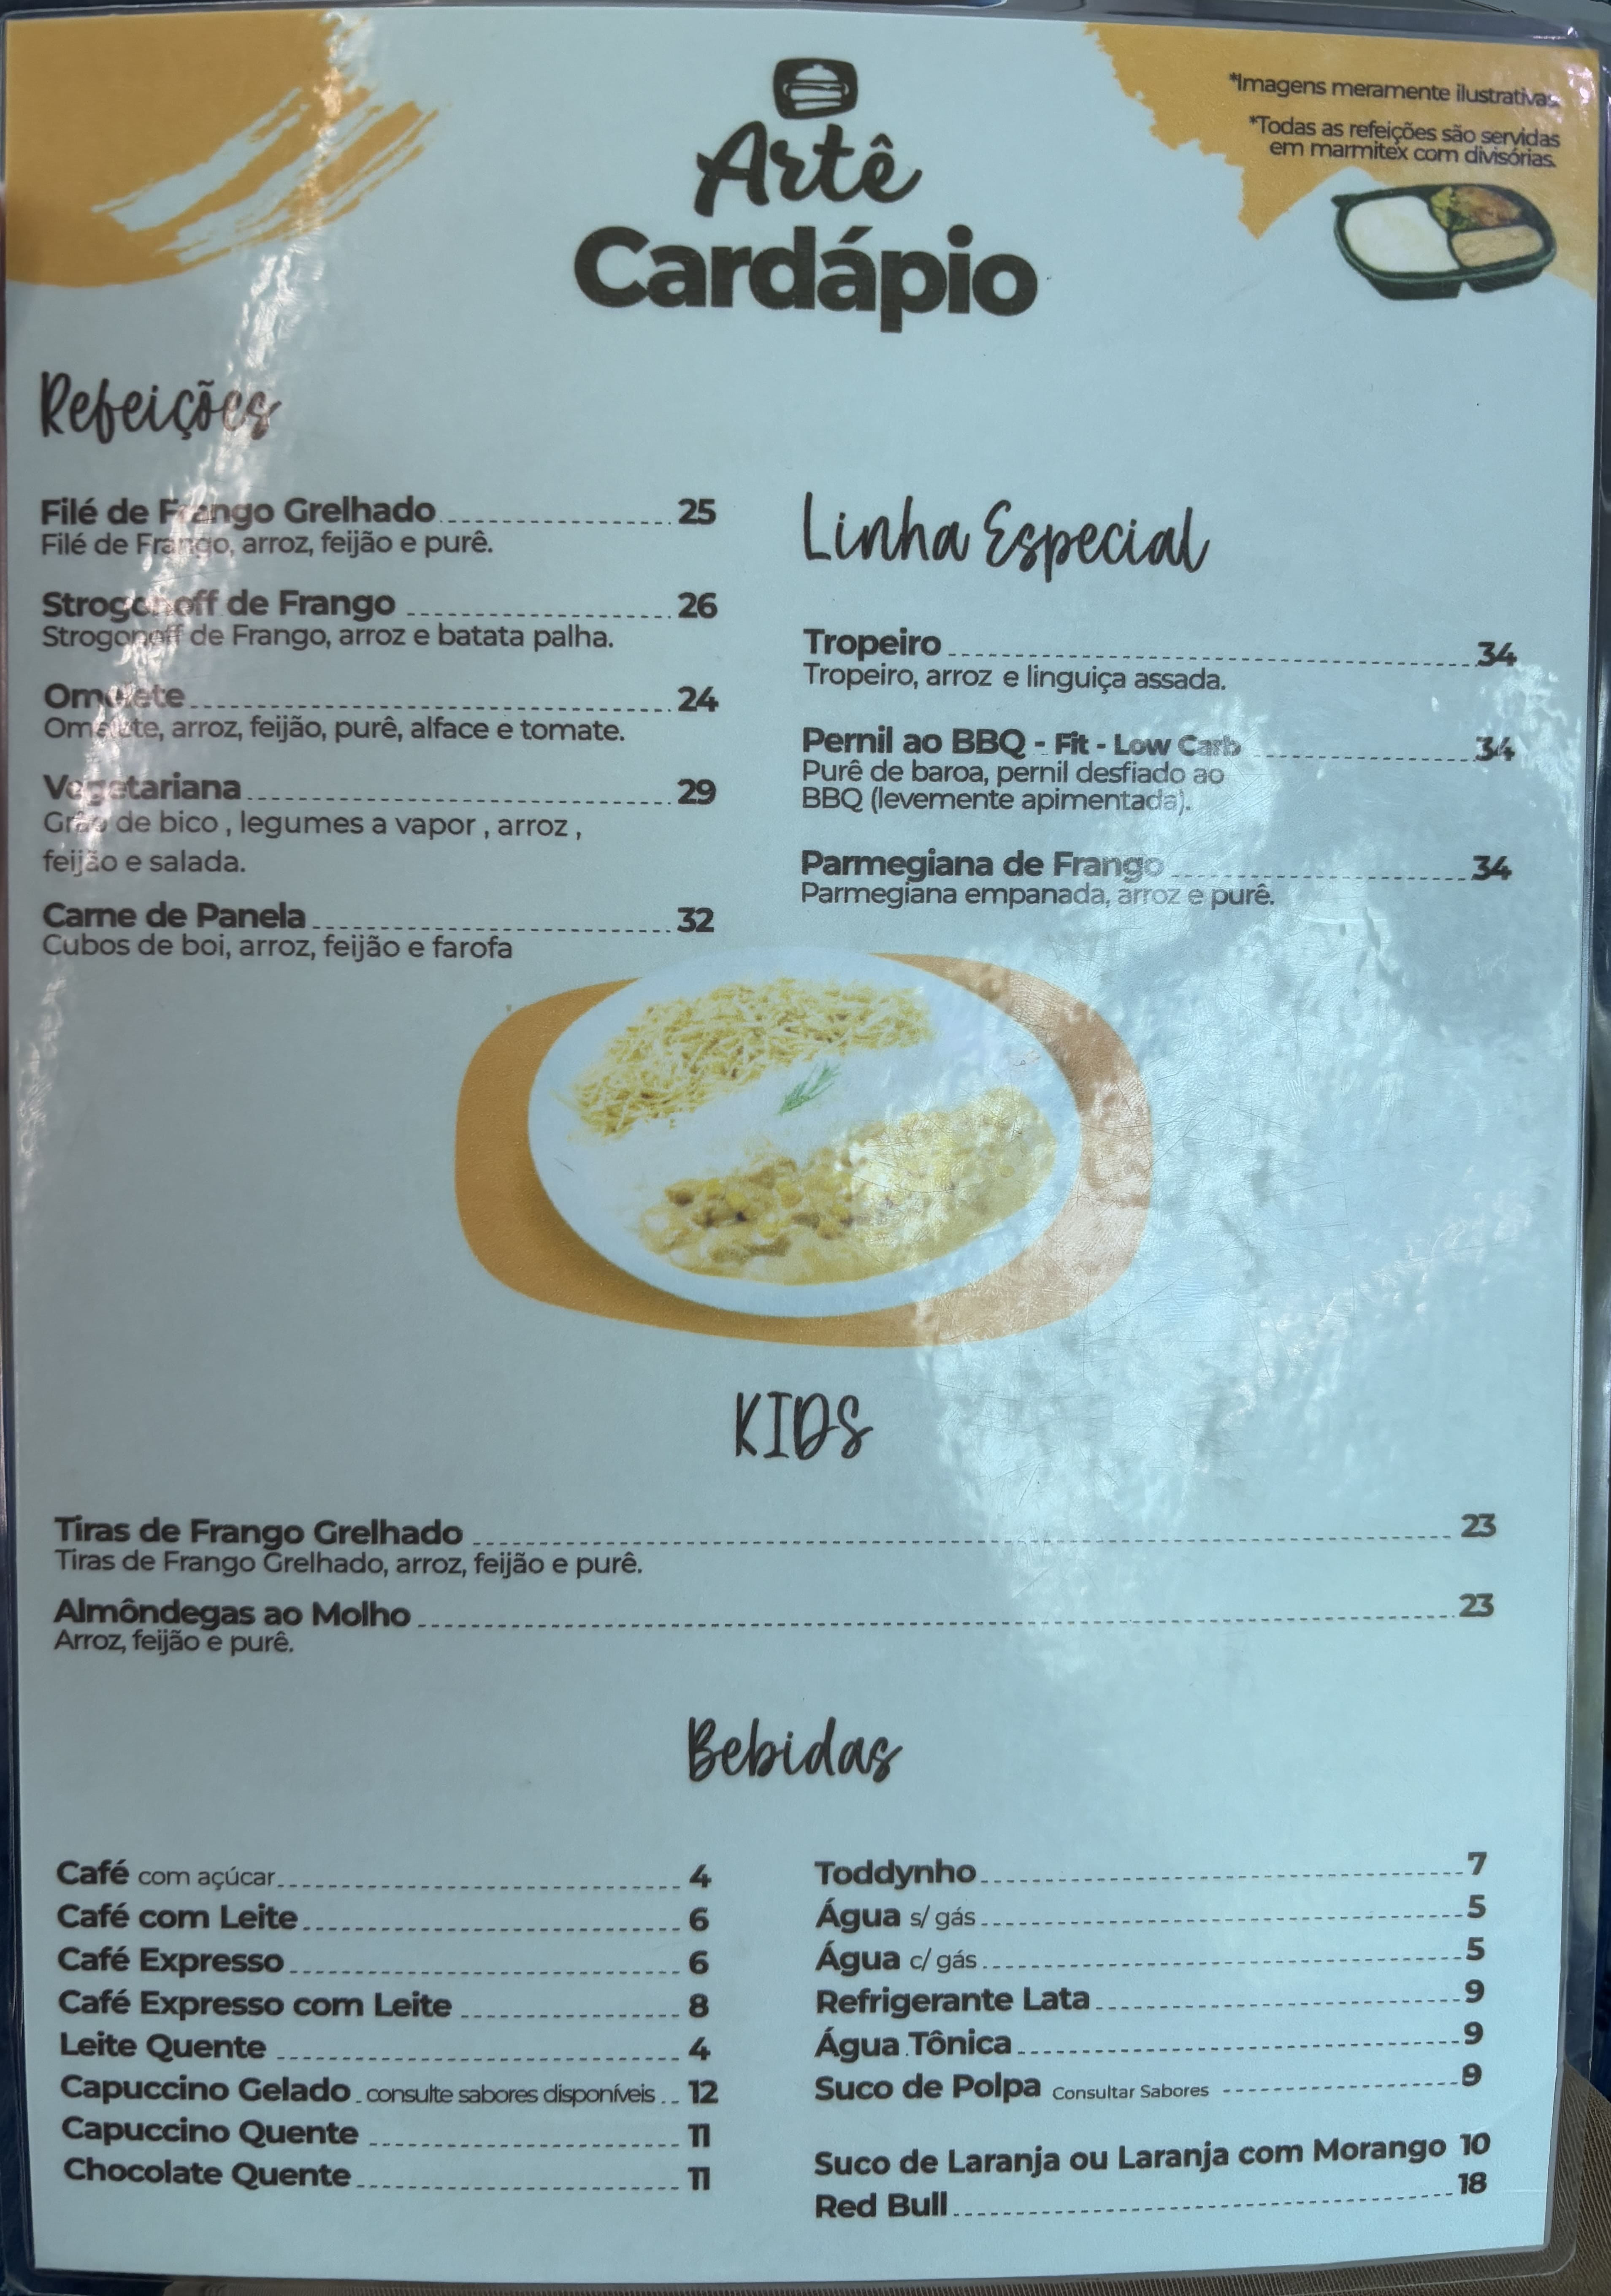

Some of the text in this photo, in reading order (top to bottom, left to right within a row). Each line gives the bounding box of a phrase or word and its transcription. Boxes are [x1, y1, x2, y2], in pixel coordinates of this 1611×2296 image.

[1332, 81, 1451, 102] meramente
[1321, 122, 1344, 138] as
[1349, 119, 1438, 146] refeições
[1441, 124, 1476, 144] são
[1481, 127, 1561, 148] servidas
[693, 120, 923, 218] Artê
[1269, 141, 1557, 168] em marmitex com divisórias.
[573, 224, 1038, 333] Cardápio
[40, 371, 281, 445] Refeições
[41, 495, 717, 525] Filé de Grelhado 25
[41, 529, 493, 559] Filé de arroz, feijão e purê.
[803, 491, 1210, 583] Linha Especial
[227, 588, 718, 623] de Frango 26
[803, 627, 1518, 667] Tropeiro 34
[803, 662, 1226, 695] Tropeiro, arroz e linguiça assada.
[677, 685, 719, 712] 24
[802, 724, 1172, 760] Pernil ao BBQ Fit Low
[802, 758, 1225, 788] Purê de baroa, pernil desfiado ao
[677, 778, 717, 805] 29
[801, 847, 1513, 883] Parmegiana de 34
[42, 901, 715, 933] Carne de Panela 32
[42, 932, 512, 963] Cubos de boi, arroz, feijão e farofa
[735, 1390, 874, 1461] KIDS
[54, 1513, 1497, 1551] Tiras de Frango Grelhado 23
[54, 1548, 642, 1580] Tiras de Frango Grelhado, arroz, feijão e purê.
[53, 1592, 1495, 1632] Almôndegas ao Molho 23
[54, 1628, 294, 1657] Arroz, feijão e purê.
[688, 1716, 903, 1783] Bebidas
[56, 1859, 712, 1891] Café com açúcar 4
[814, 1851, 1487, 1891] Toddynho 7
[57, 1902, 709, 1932] Café com Leite 6
[815, 1897, 901, 1934] Água
[934, 1906, 976, 1931] gás
[1467, 1894, 1486, 1919] 5
[57, 1945, 709, 1979] Café Expresso 6
[815, 1940, 901, 1977] Água
[936, 1949, 977, 1974] gás
[1466, 1936, 1485, 1961] 5
[58, 1988, 709, 2022] Café Expresso com Leite 8
[816, 1979, 1485, 2020] Refrigerante Lata 9
[60, 2030, 711, 2063] Leite Quente 4
[814, 2021, 1484, 2064] Água Tônica 9
[60, 2074, 719, 2108] Capuccino Gelado consulte sabores disponíveis 12
[815, 2063, 1483, 2104] Suco de Polpa Consultar Sabores 9
[61, 2115, 710, 2149] Capuccino Quente 11
[814, 2132, 1491, 2179] Suco de Laranja ou Laranja com Morango 10
[63, 2156, 710, 2191] Chocolate Quente 11
[815, 2171, 1487, 2218] Red Bull 18
